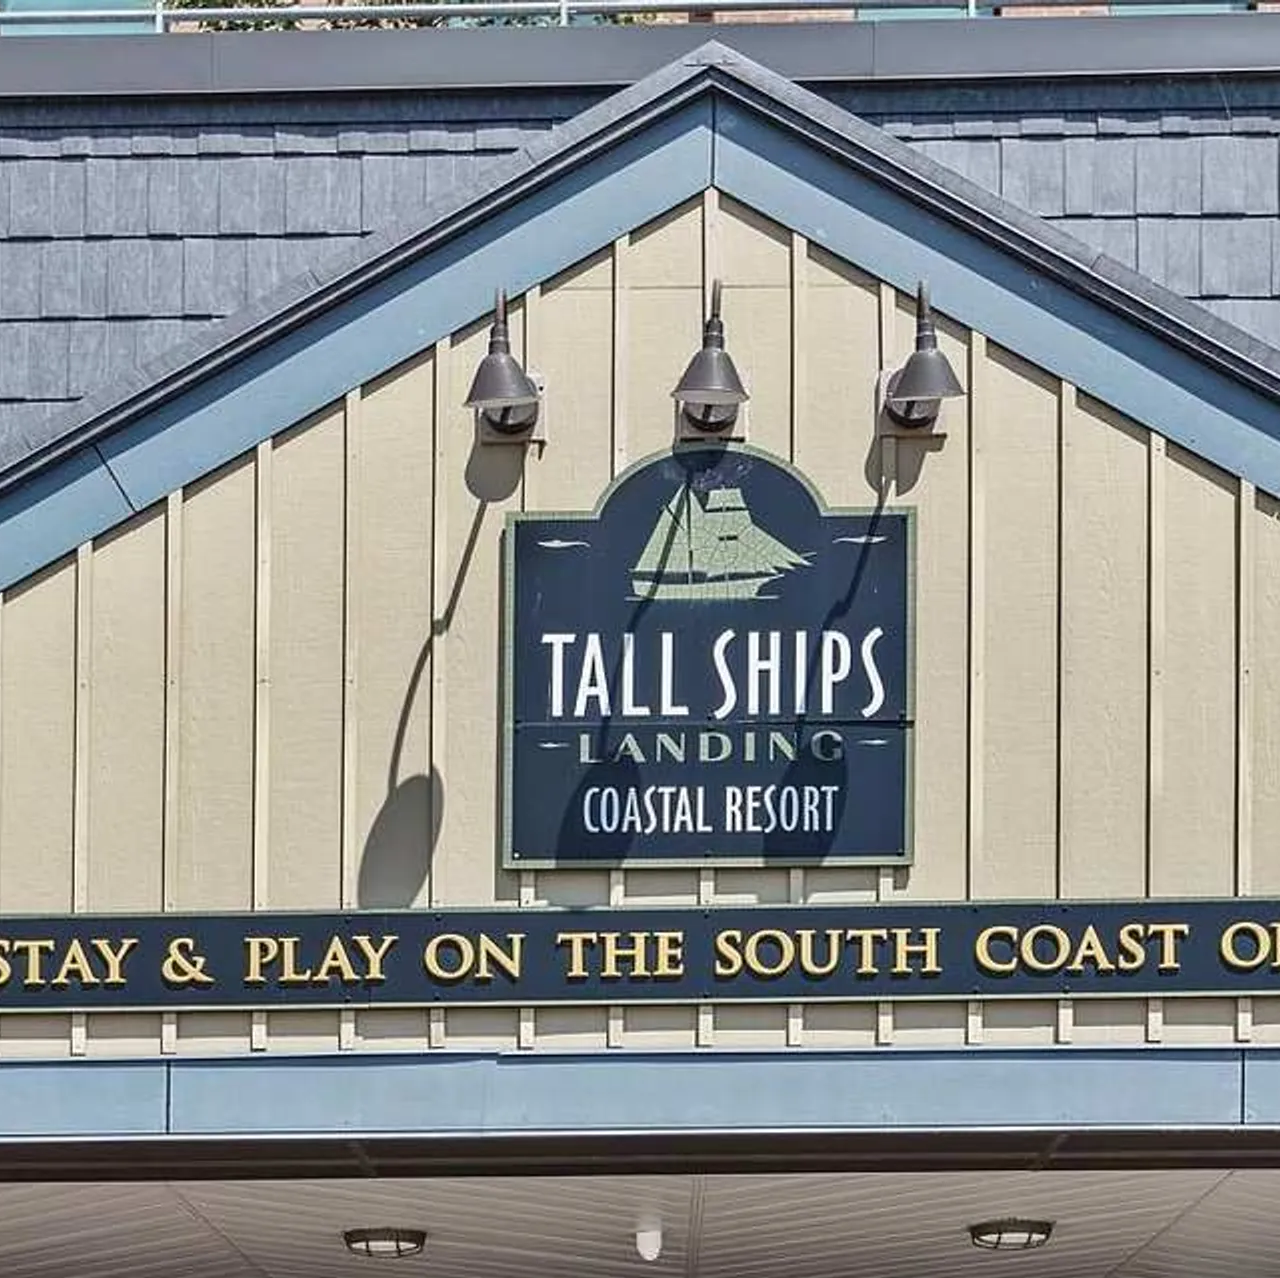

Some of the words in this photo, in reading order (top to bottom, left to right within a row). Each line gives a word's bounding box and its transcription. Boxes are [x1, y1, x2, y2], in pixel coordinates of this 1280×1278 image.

[541, 631, 690, 718] TALL
[712, 626, 886, 720] SHIPS
[578, 731, 846, 764] LANDING
[583, 785, 713, 835] COASTAL
[725, 784, 840, 834] RESORT
[160, 936, 213, 984] &
[244, 934, 396, 983] PLAY
[423, 931, 523, 980] ON
[557, 930, 684, 978] THE
[714, 927, 941, 976] SOUTH
[974, 923, 1187, 972] COAST
